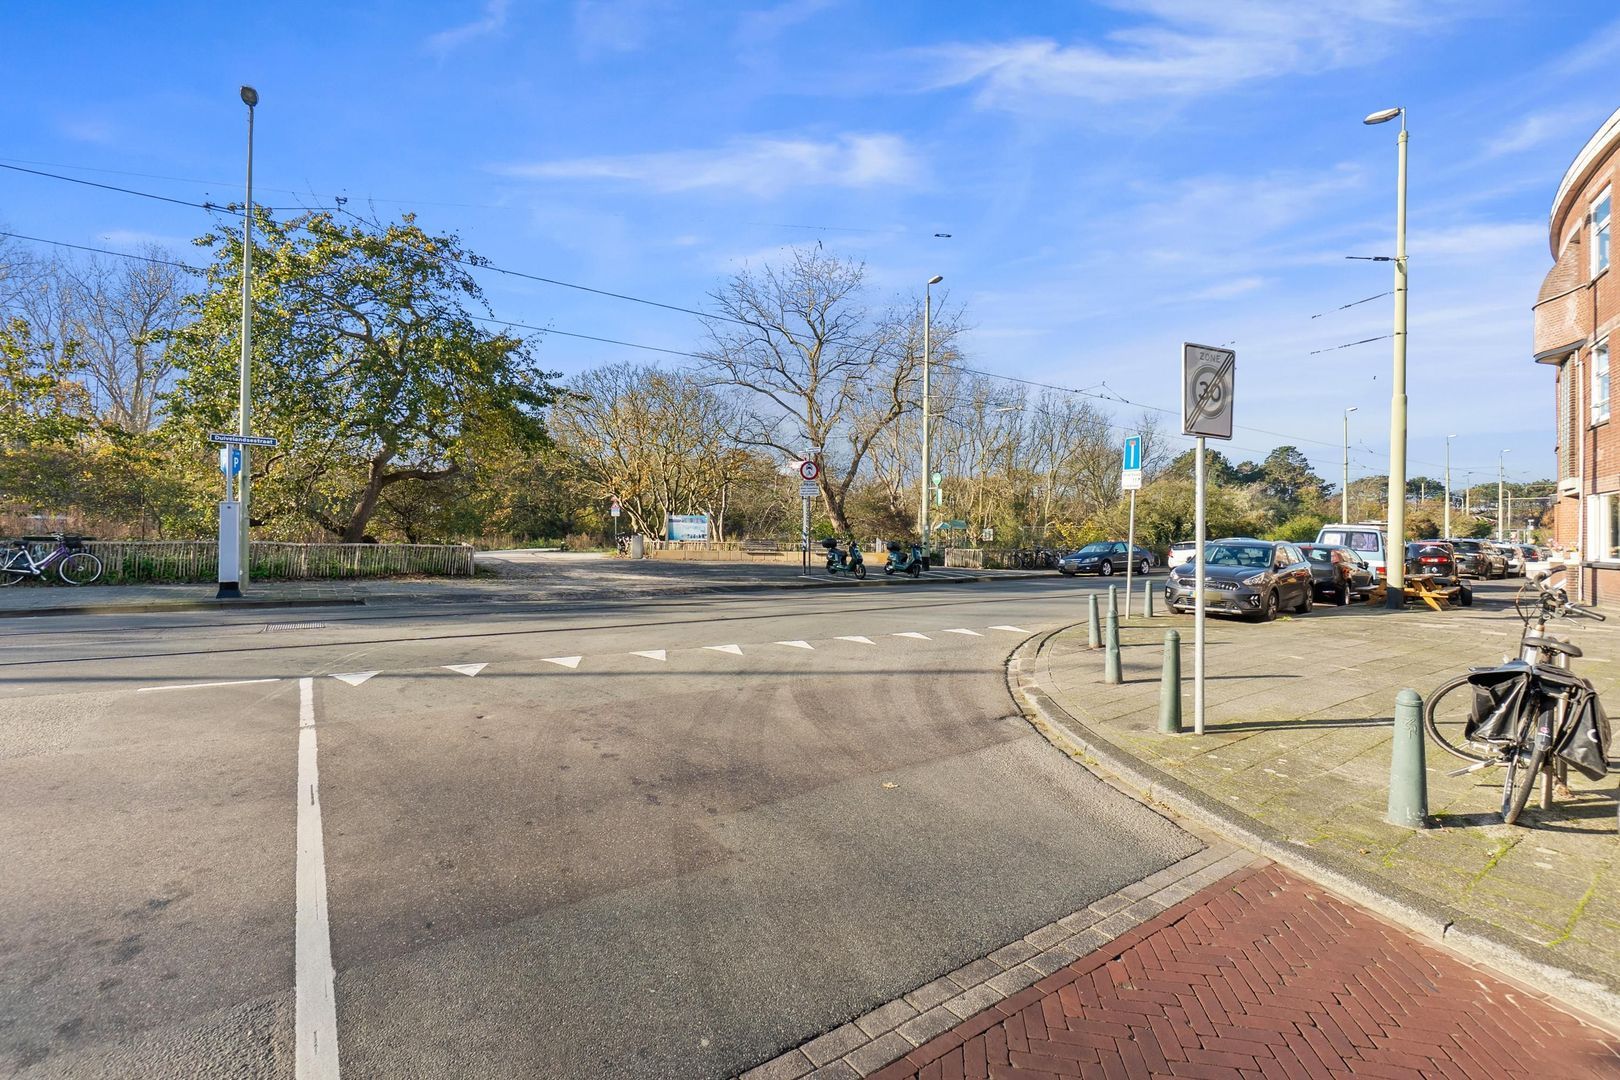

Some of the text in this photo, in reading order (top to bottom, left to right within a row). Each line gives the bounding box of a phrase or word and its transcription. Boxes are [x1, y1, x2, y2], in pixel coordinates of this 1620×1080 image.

[1199, 352, 1221, 363] ZONE
[1198, 381, 1221, 402] 30
[214, 435, 273, 444] Duivelandsestraat
[234, 457, 239, 468] P
